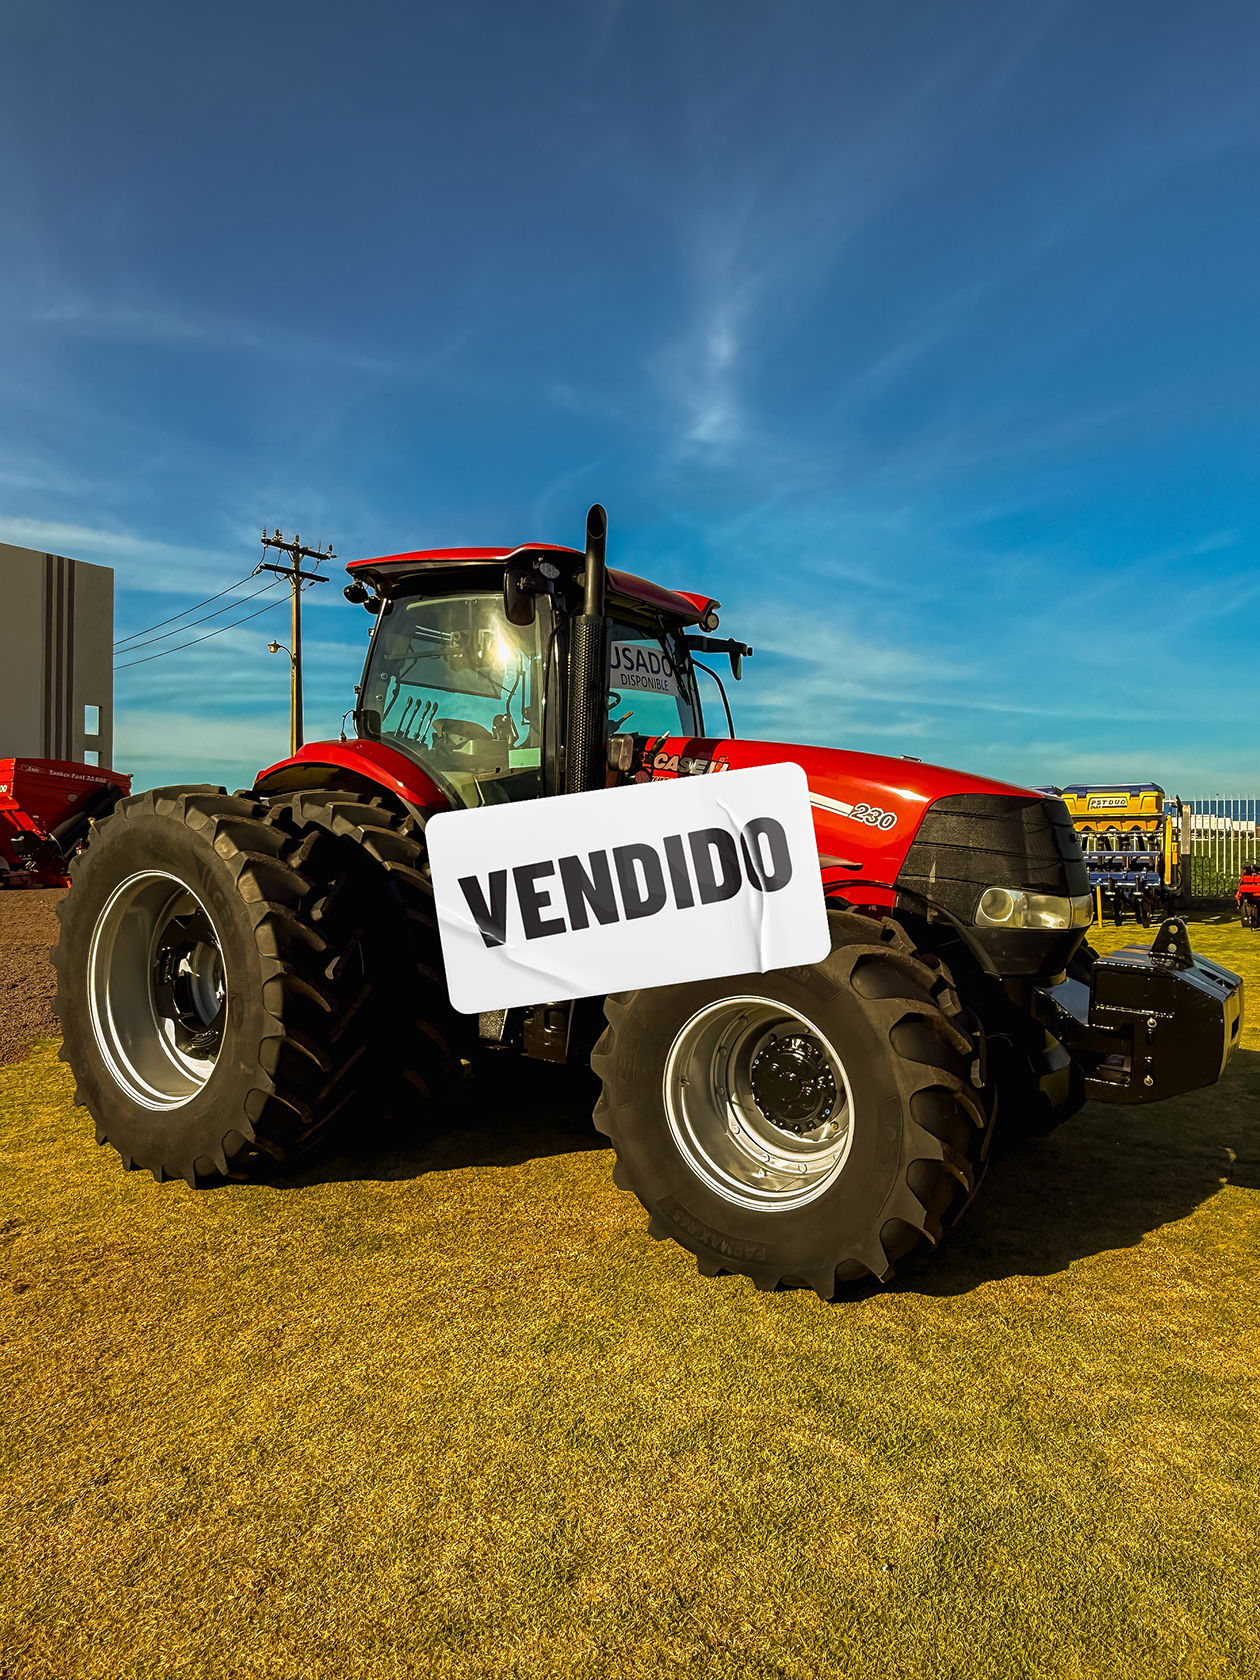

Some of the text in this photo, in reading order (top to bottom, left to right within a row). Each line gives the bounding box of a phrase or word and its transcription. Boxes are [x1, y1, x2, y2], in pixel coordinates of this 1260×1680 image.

[621, 674, 669, 691] DISPONIBLE
[49, 769, 70, 777] Tanker
[653, 753, 708, 774] CASE
[850, 803, 897, 830] 230
[700, 1229, 766, 1261] FARMAX
